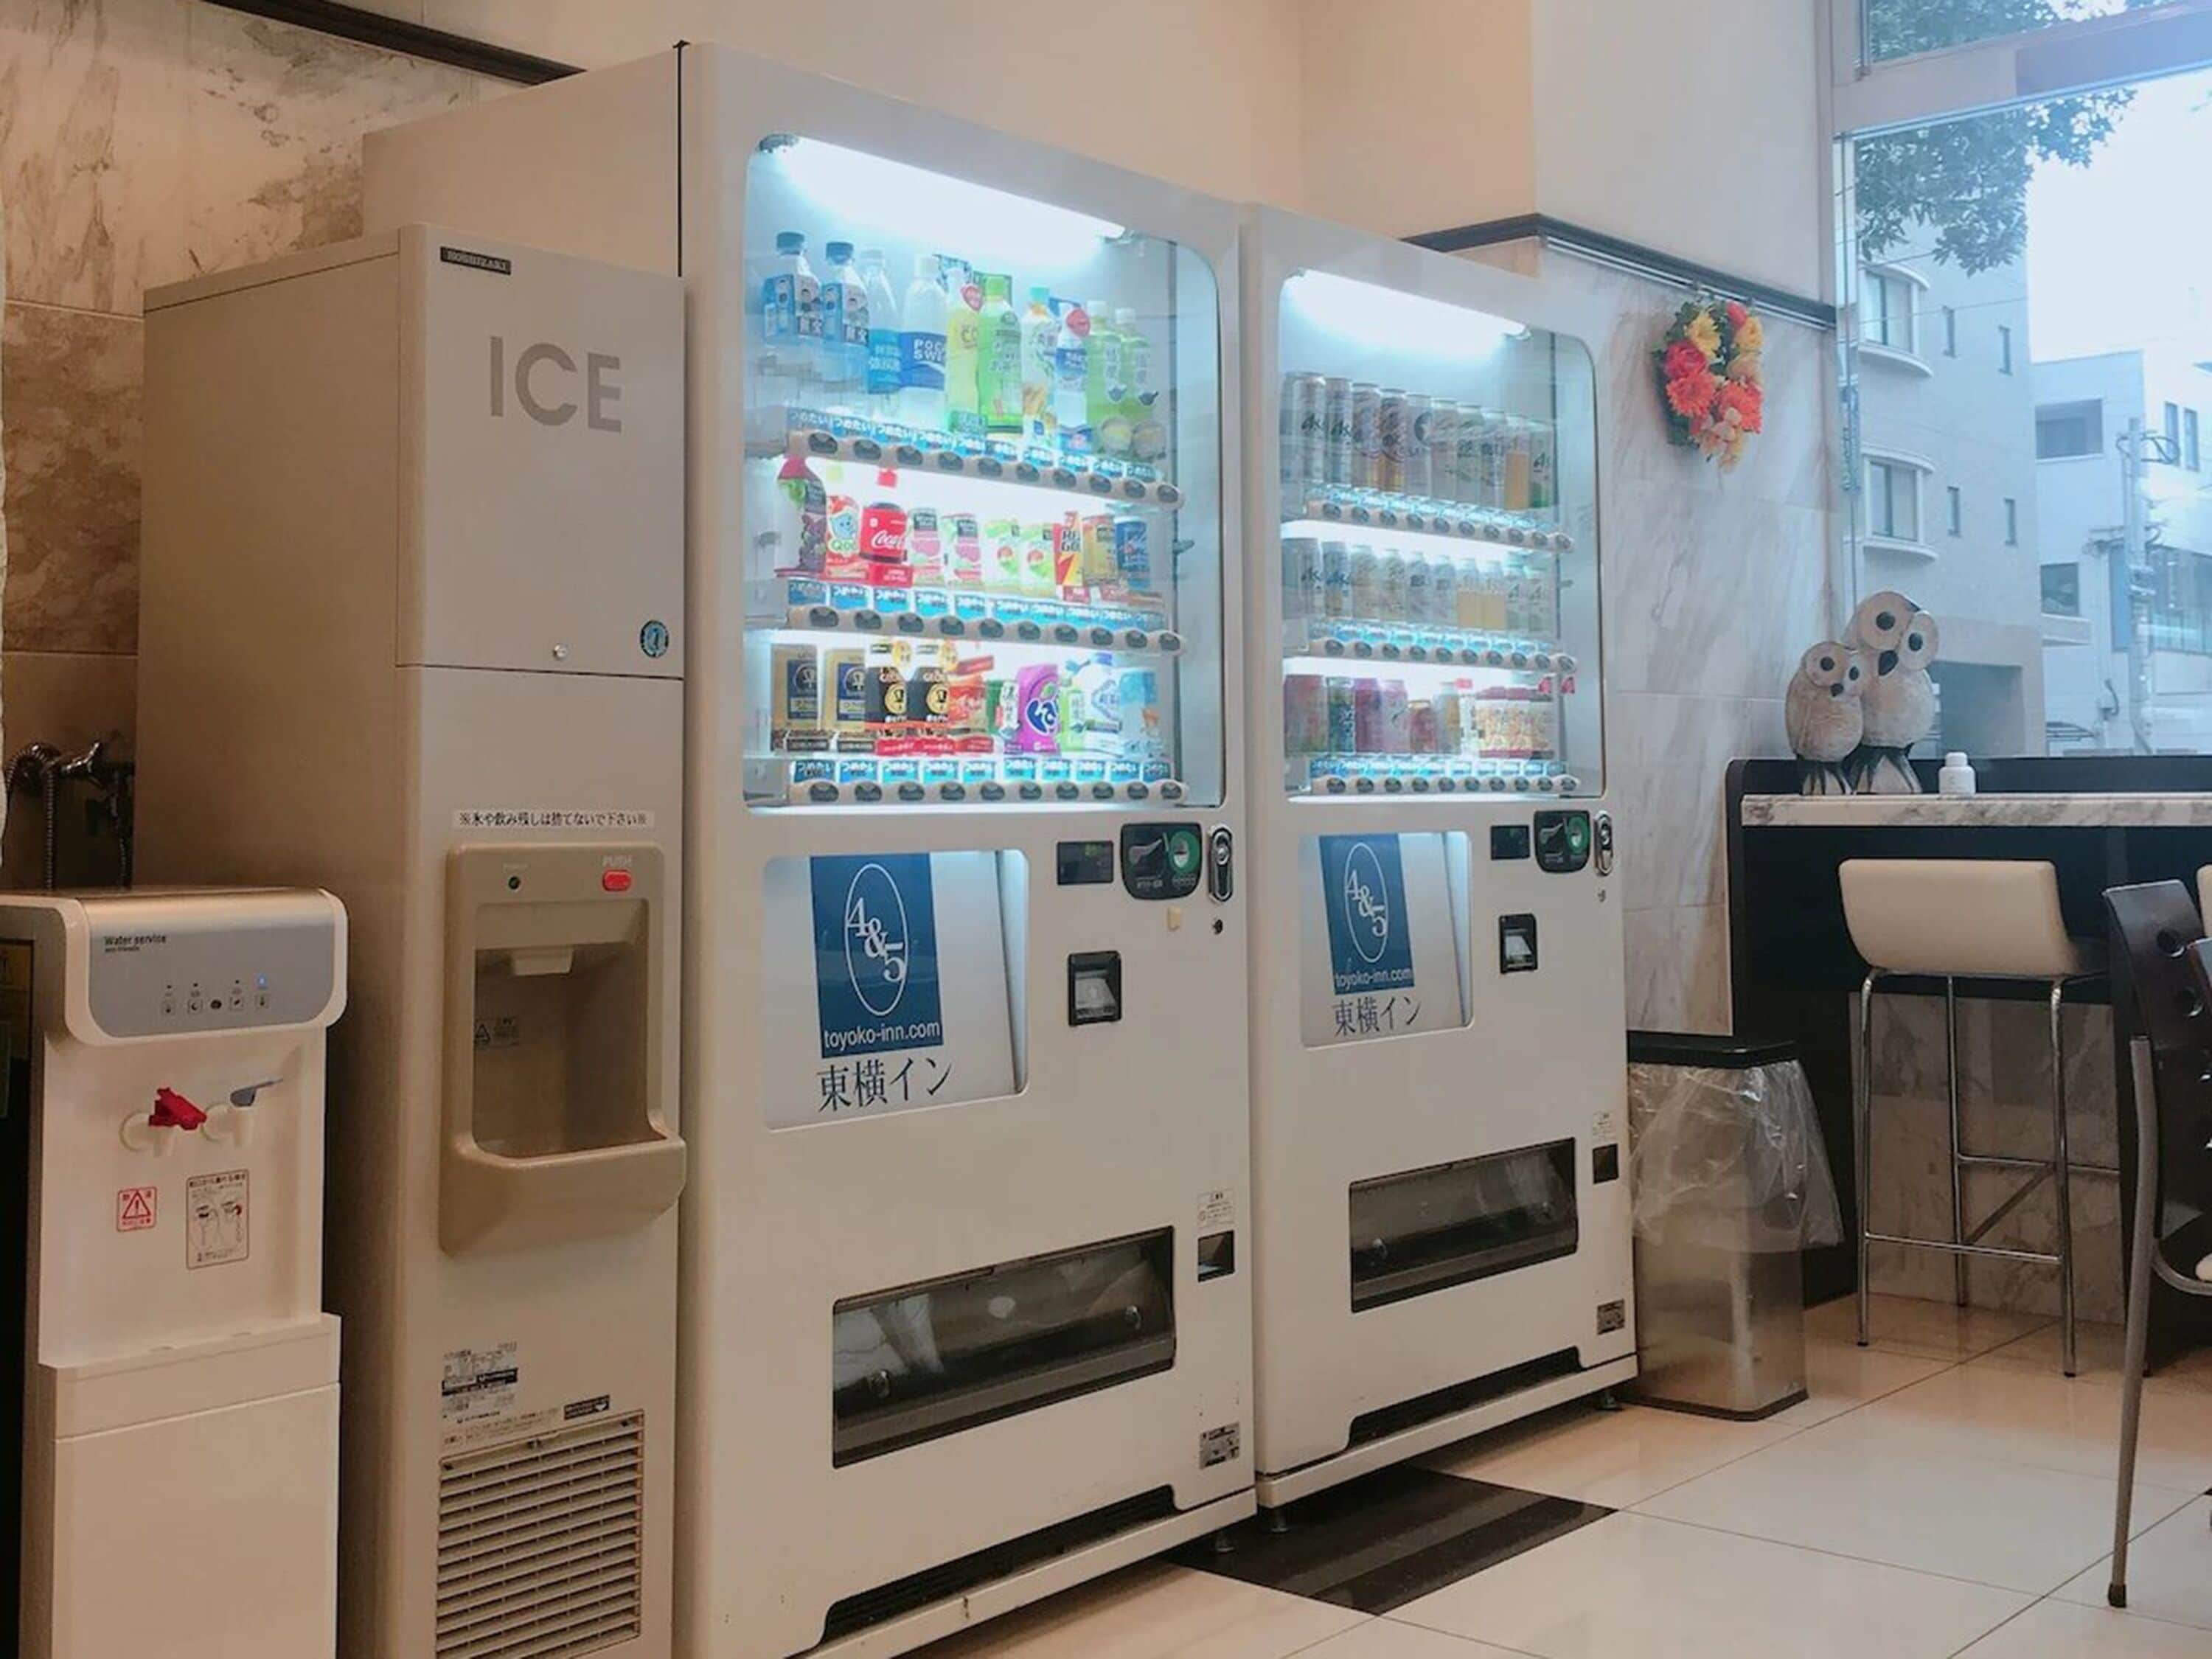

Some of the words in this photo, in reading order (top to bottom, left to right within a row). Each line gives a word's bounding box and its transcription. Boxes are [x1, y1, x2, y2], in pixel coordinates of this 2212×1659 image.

[490, 335, 621, 433] ICE
[1345, 869, 1387, 936] 4&5
[847, 897, 905, 983] 4&5
[1335, 967, 1413, 990] toyoko-inn.com
[824, 1019, 941, 1052] toyoko-inn.com
[1332, 996, 1422, 1037] 東横イン
[816, 1057, 953, 1113] 東横イン
